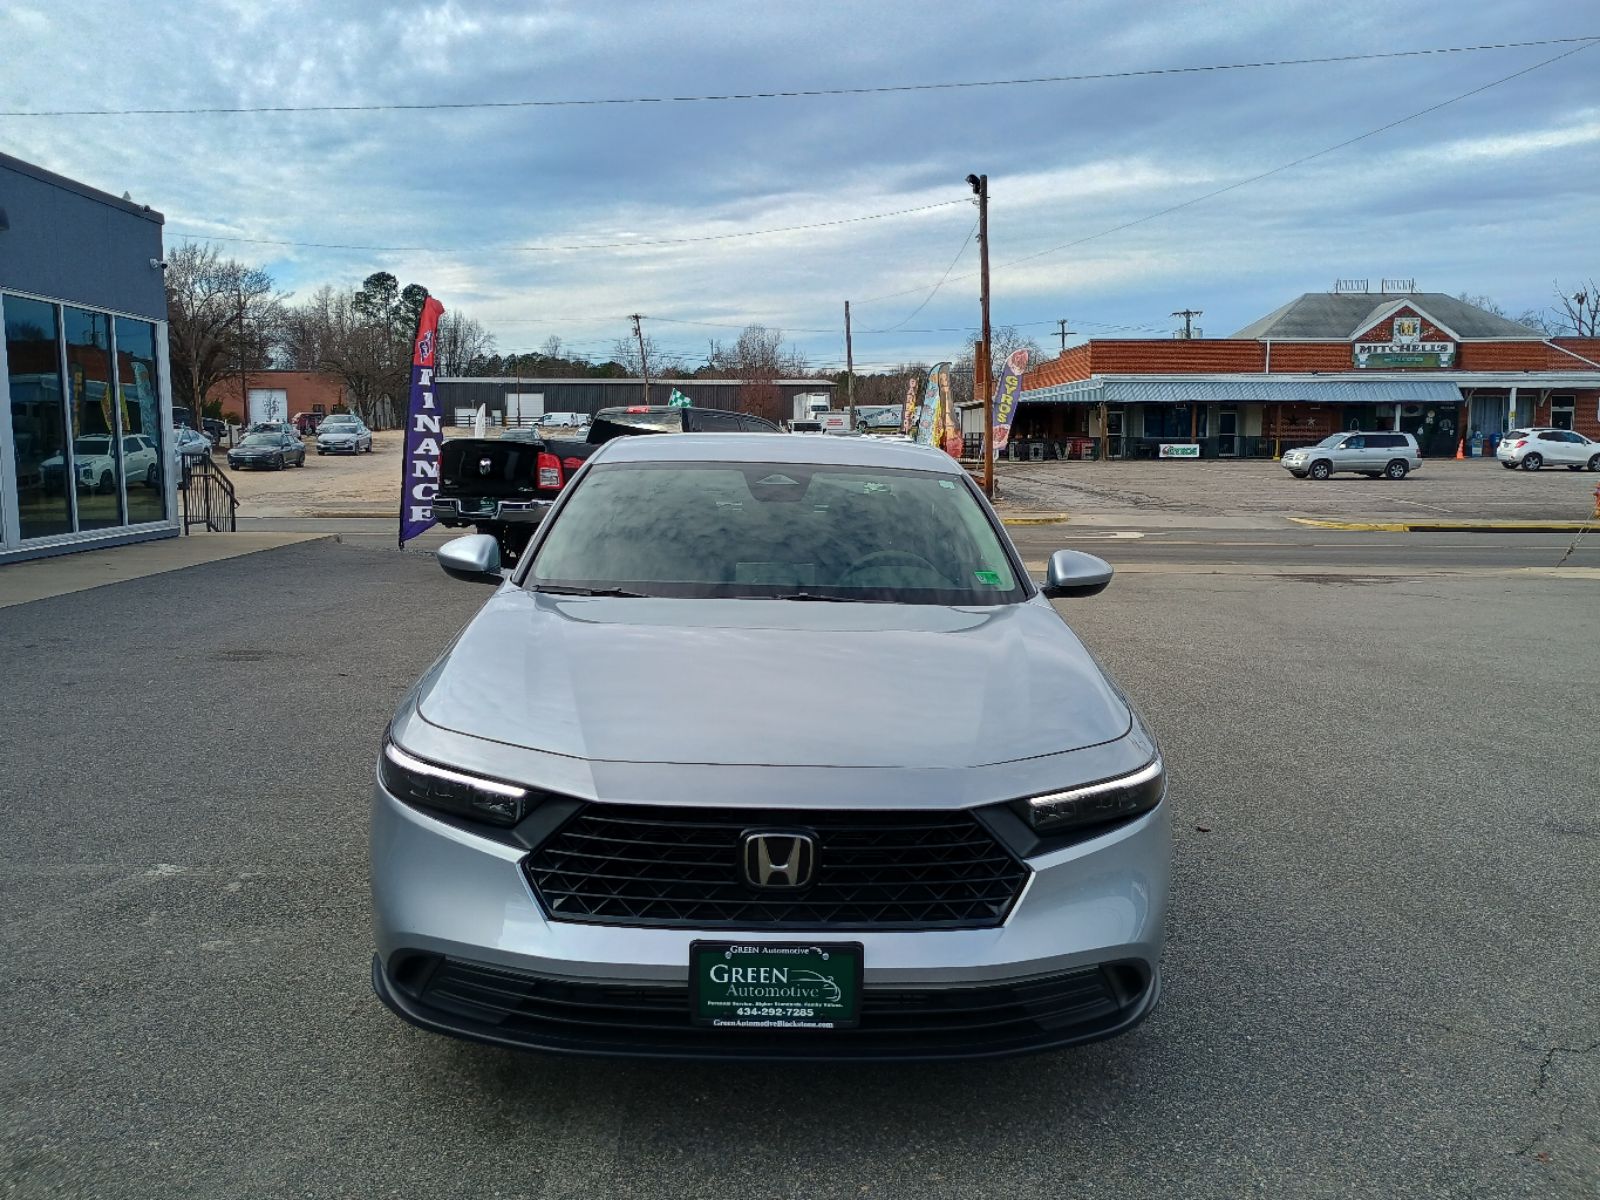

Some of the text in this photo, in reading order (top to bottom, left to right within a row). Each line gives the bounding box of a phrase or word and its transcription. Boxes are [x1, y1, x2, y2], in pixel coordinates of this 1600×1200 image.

[1360, 344, 1448, 353] MITCHELL'S
[997, 375, 1019, 424] GYROS
[409, 368, 440, 522] FINANCE
[1008, 440, 1095, 462] LOVE
[730, 945, 810, 955] GREEN Automotive
[709, 964, 789, 984] GREEN
[725, 983, 820, 998] Automotive
